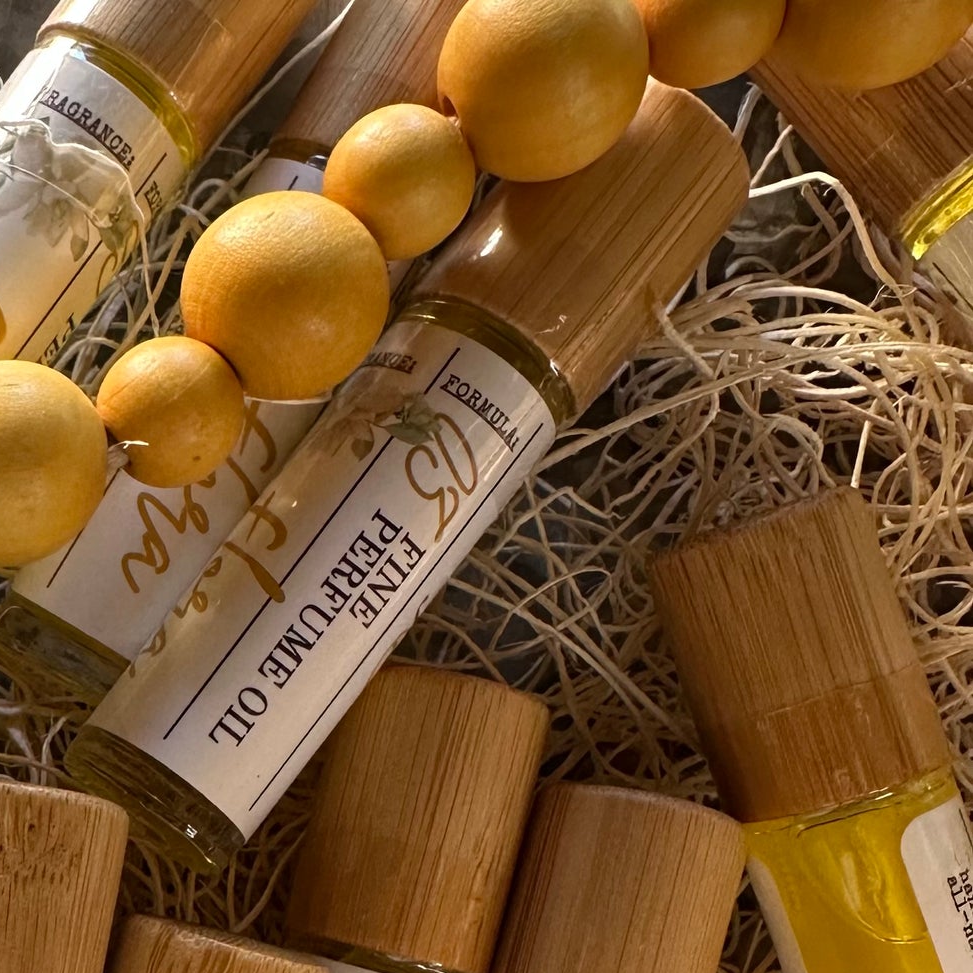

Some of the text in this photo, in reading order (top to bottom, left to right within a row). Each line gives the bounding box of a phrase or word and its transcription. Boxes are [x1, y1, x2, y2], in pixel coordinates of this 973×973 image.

[41, 88, 135, 172] RAGRANCE:
[439, 374, 521, 452] FORMULA:
[349, 528, 427, 630] FINE
[208, 508, 404, 747] PERFUME OIL
